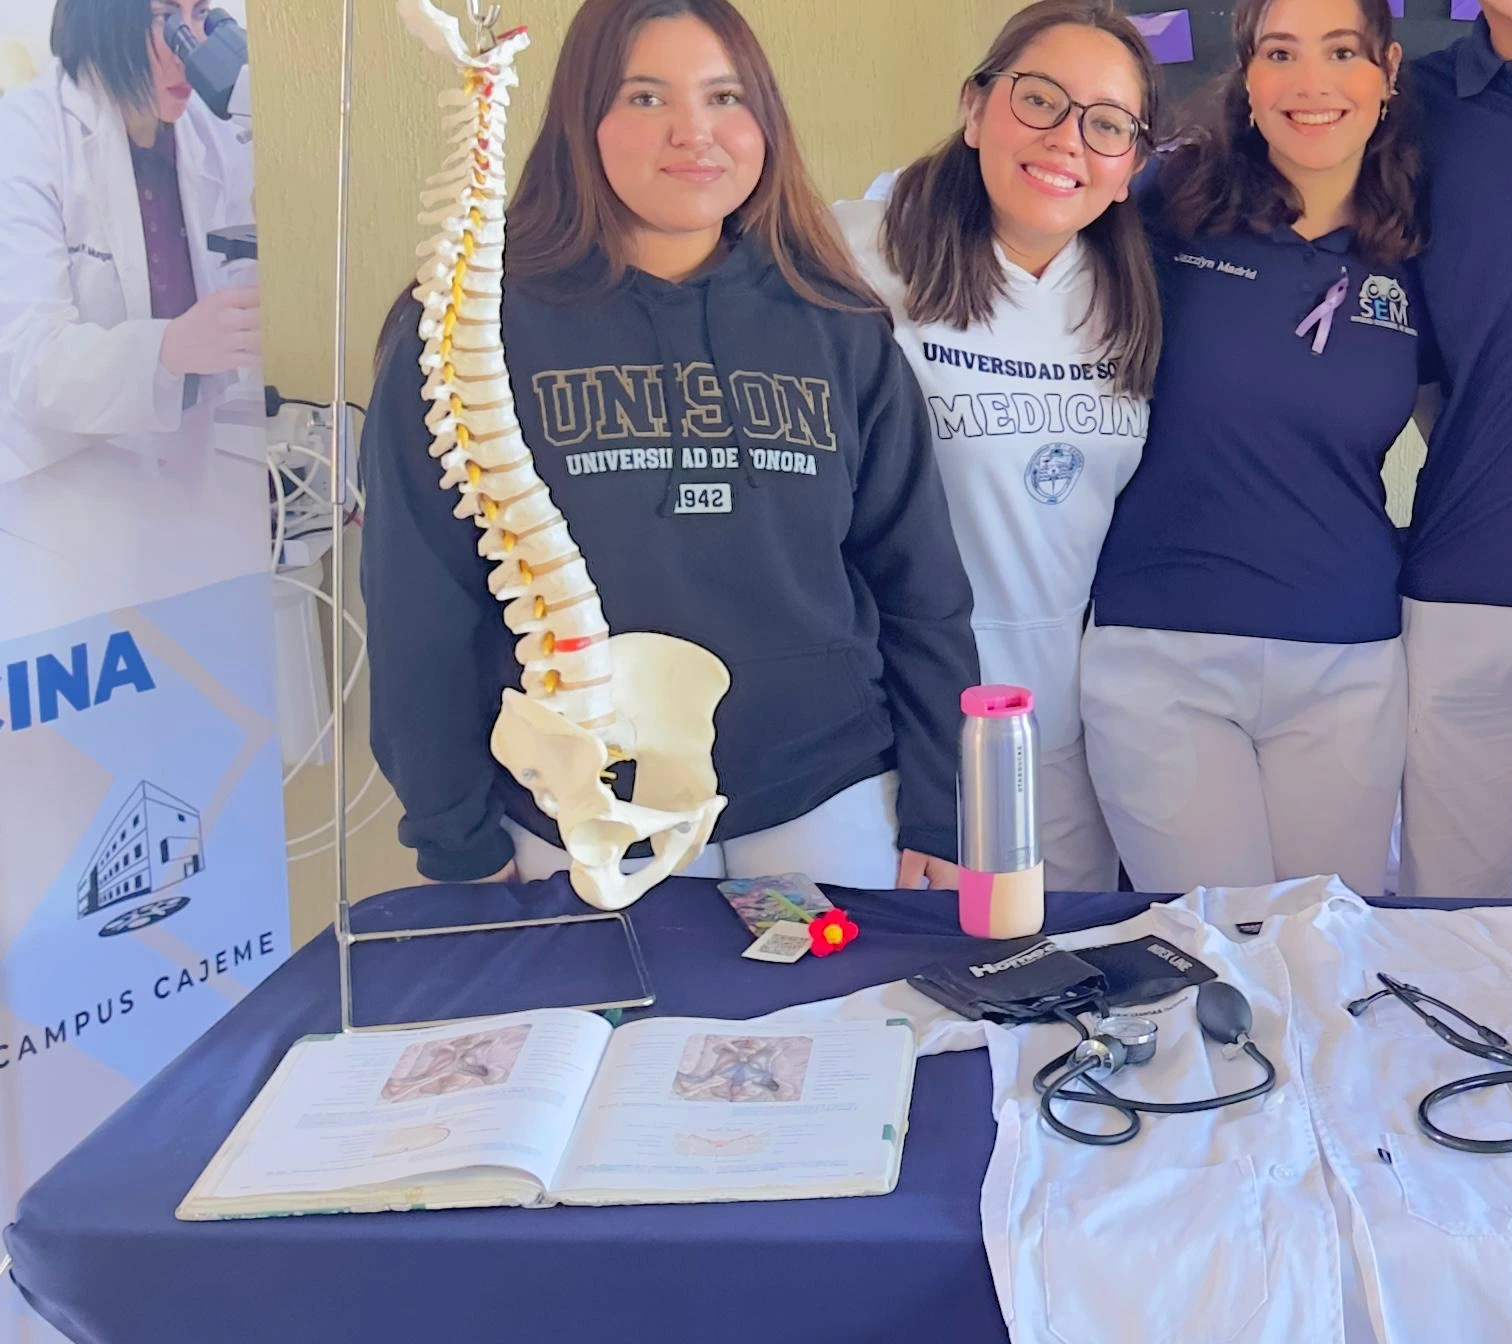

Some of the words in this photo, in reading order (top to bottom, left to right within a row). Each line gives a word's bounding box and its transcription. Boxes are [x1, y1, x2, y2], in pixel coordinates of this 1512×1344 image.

[1359, 298, 1408, 326] SEM
[923, 342, 1065, 381] UNIVERSIDAD
[1070, 363, 1094, 381] DE
[928, 392, 1147, 440] MEDICIN
[711, 447, 740, 470] DE
[748, 449, 817, 476] ONORA
[678, 489, 723, 508] 1942
[0, 630, 155, 732] INA
[154, 931, 275, 1000] CAJEME
